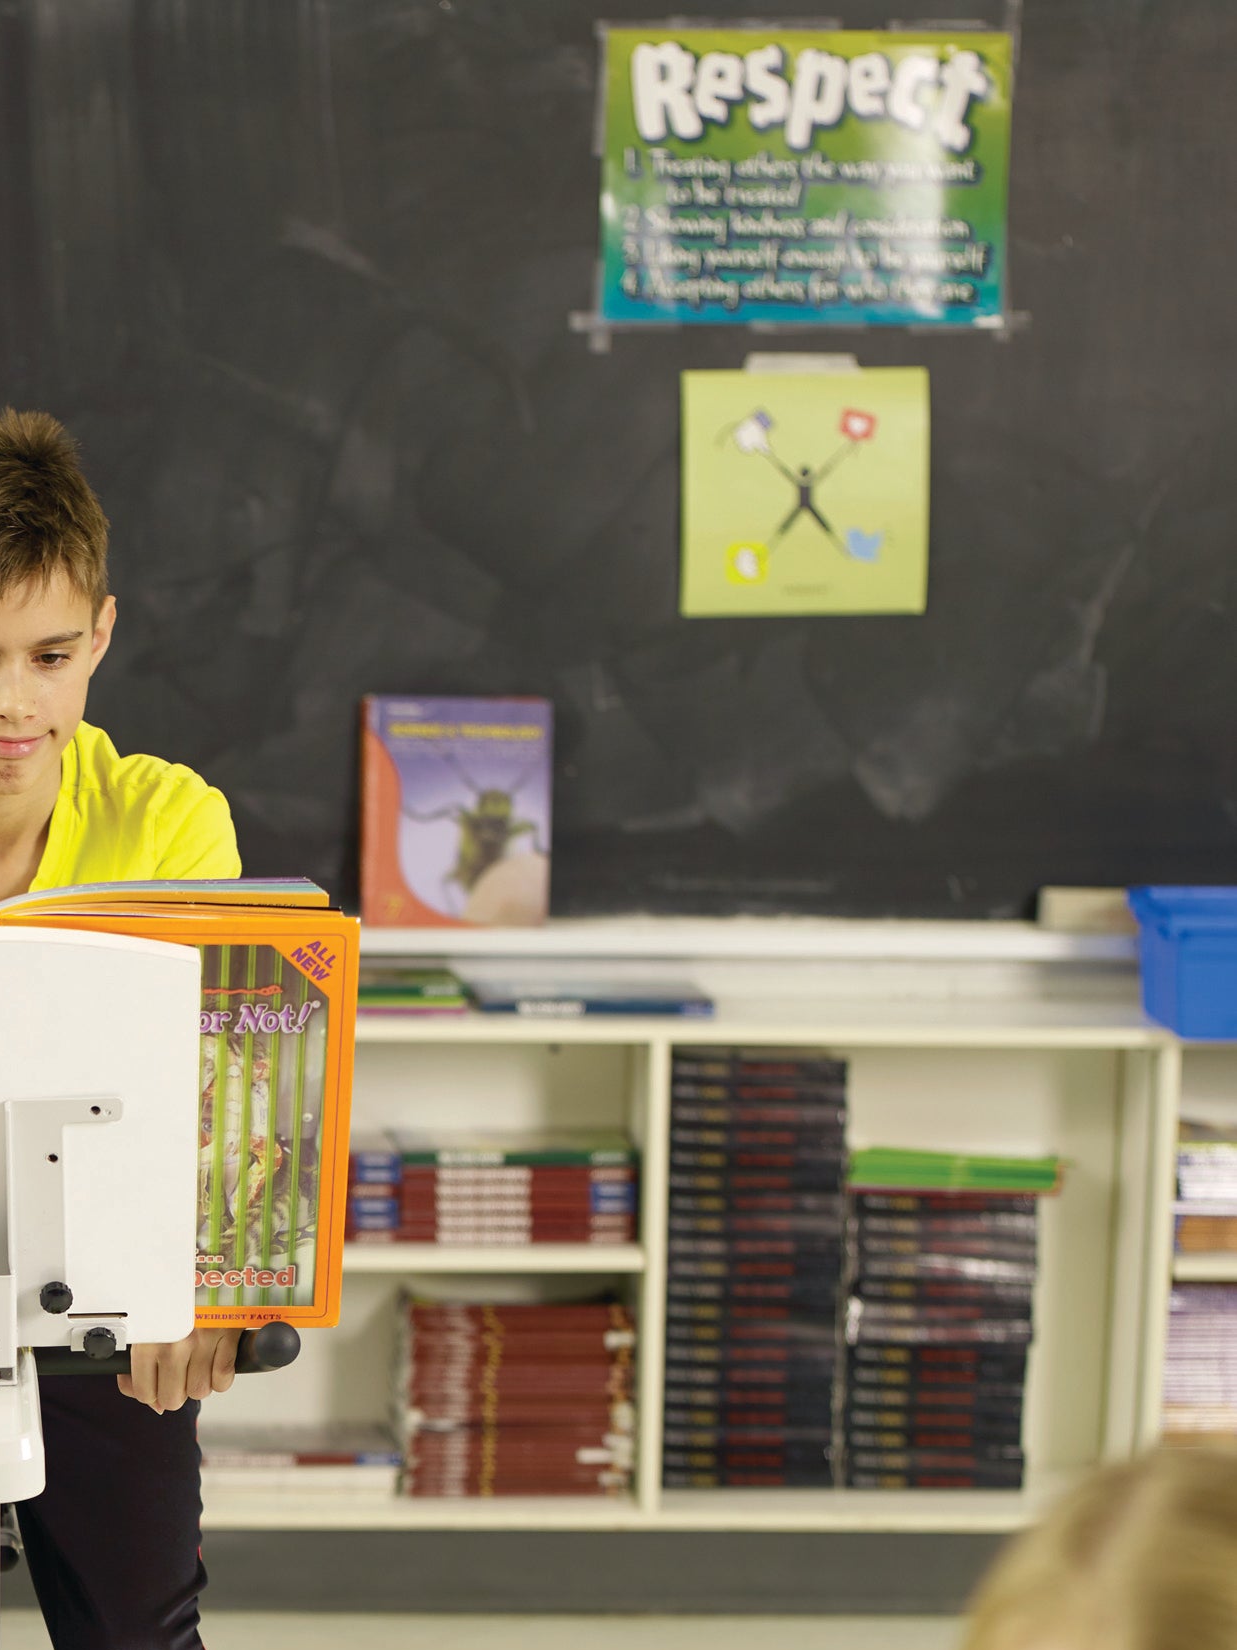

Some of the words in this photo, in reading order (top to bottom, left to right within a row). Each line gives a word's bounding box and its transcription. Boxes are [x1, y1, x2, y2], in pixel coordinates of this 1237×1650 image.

[632, 41, 991, 152] Respect
[291, 947, 330, 981] NEW
[306, 940, 336, 969] ALL
[234, 1001, 312, 1033] Not!
